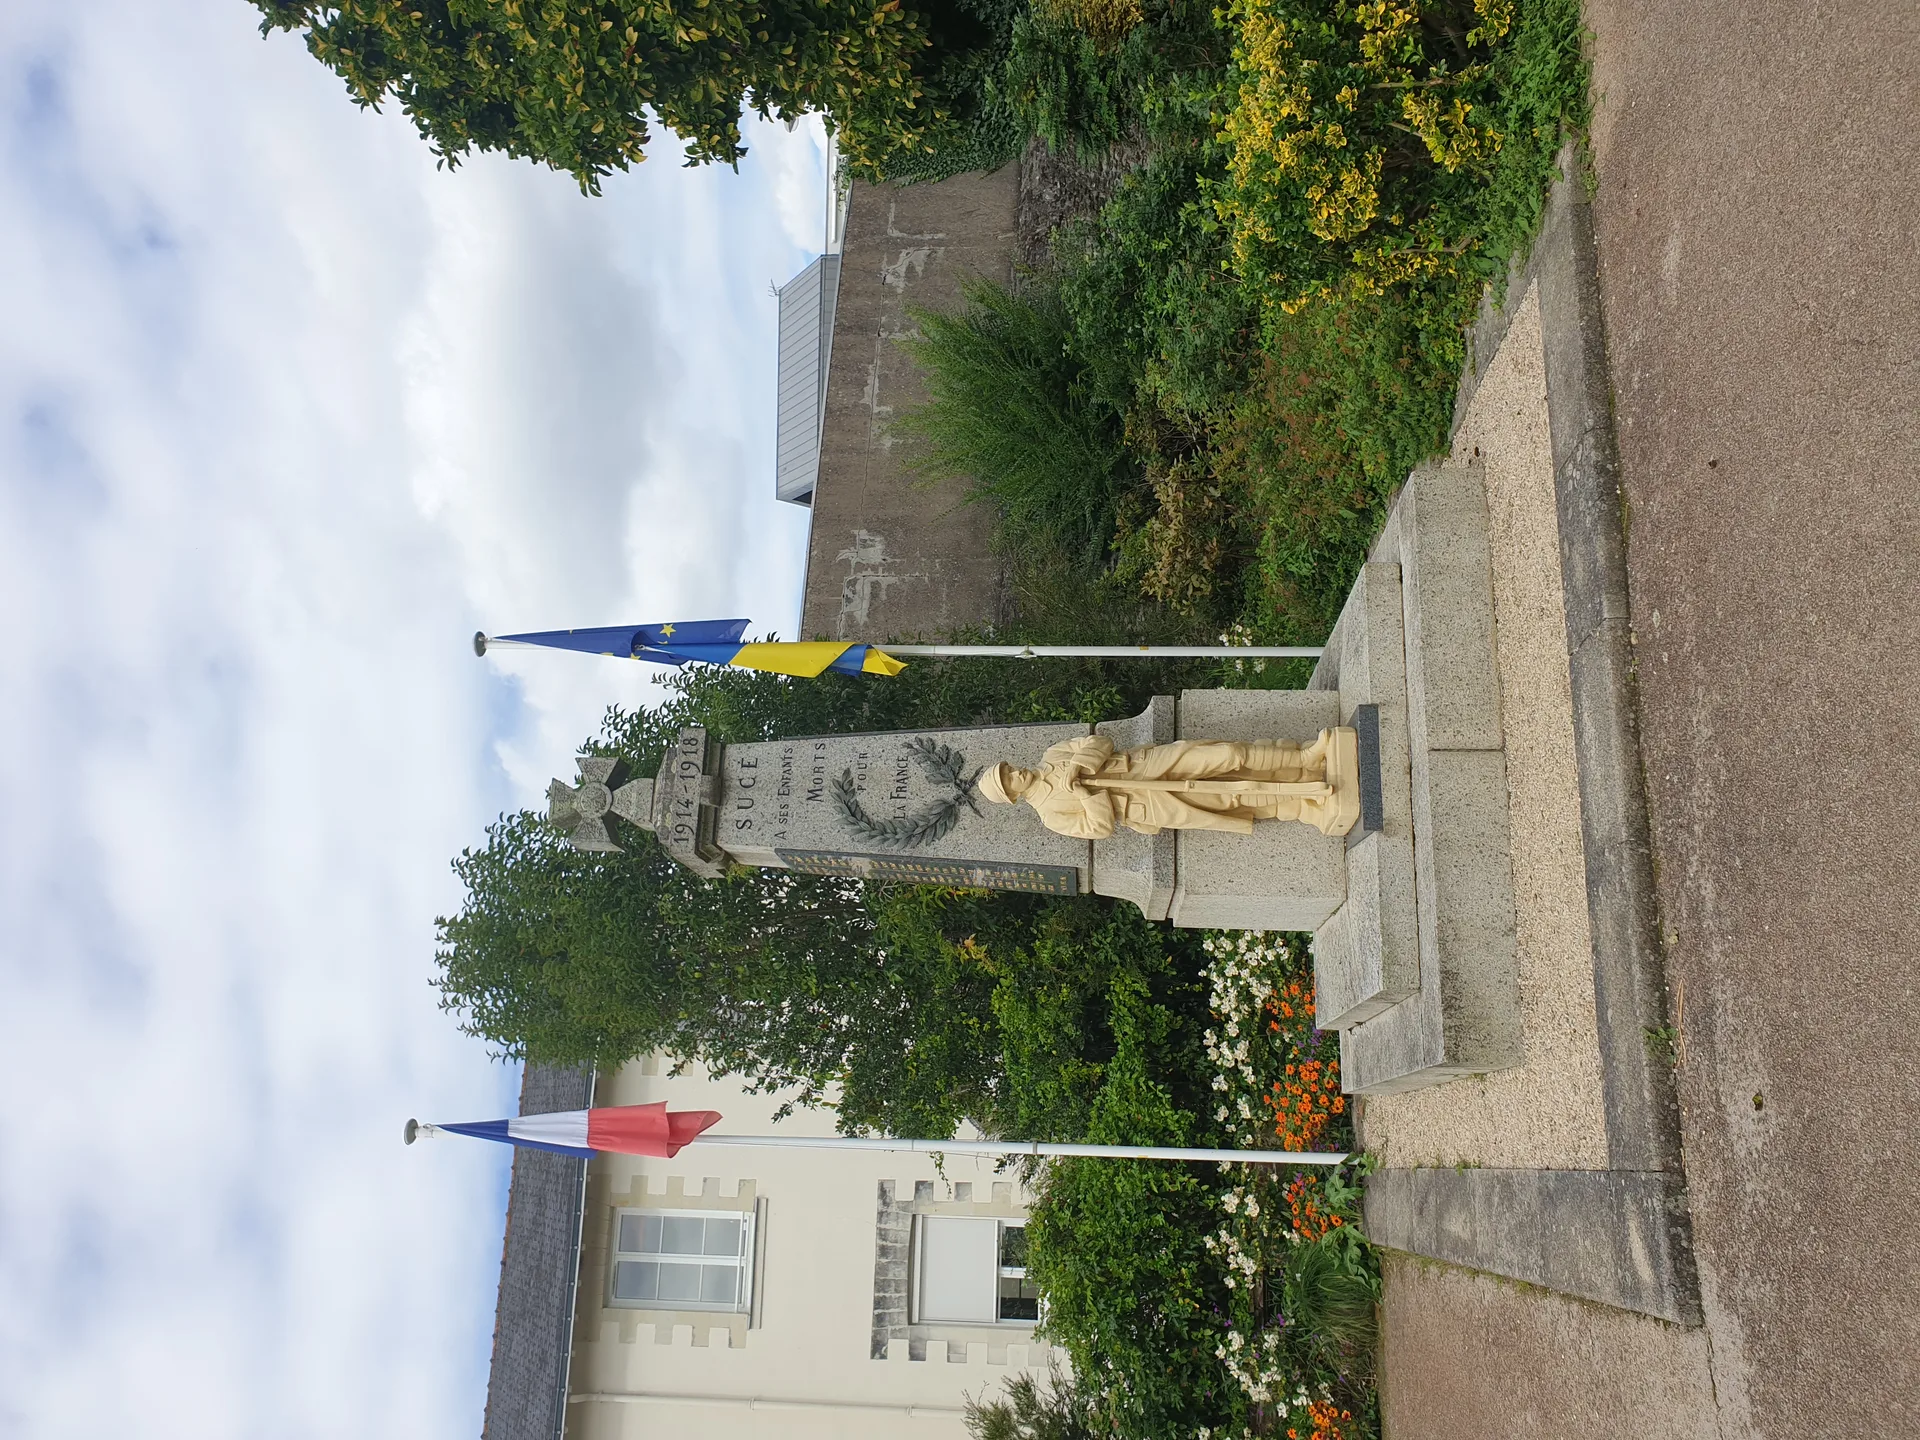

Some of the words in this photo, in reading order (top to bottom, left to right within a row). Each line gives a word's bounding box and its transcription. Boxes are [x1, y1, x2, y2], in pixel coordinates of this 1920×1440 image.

[673, 737, 700, 844] 1914-1918
[806, 743, 826, 802] MORTS
[856, 752, 868, 791] POUR
[889, 755, 909, 800] FRANCE
[778, 803, 789, 825] SES
[893, 804, 906, 820] LA
[774, 830, 787, 840] A
